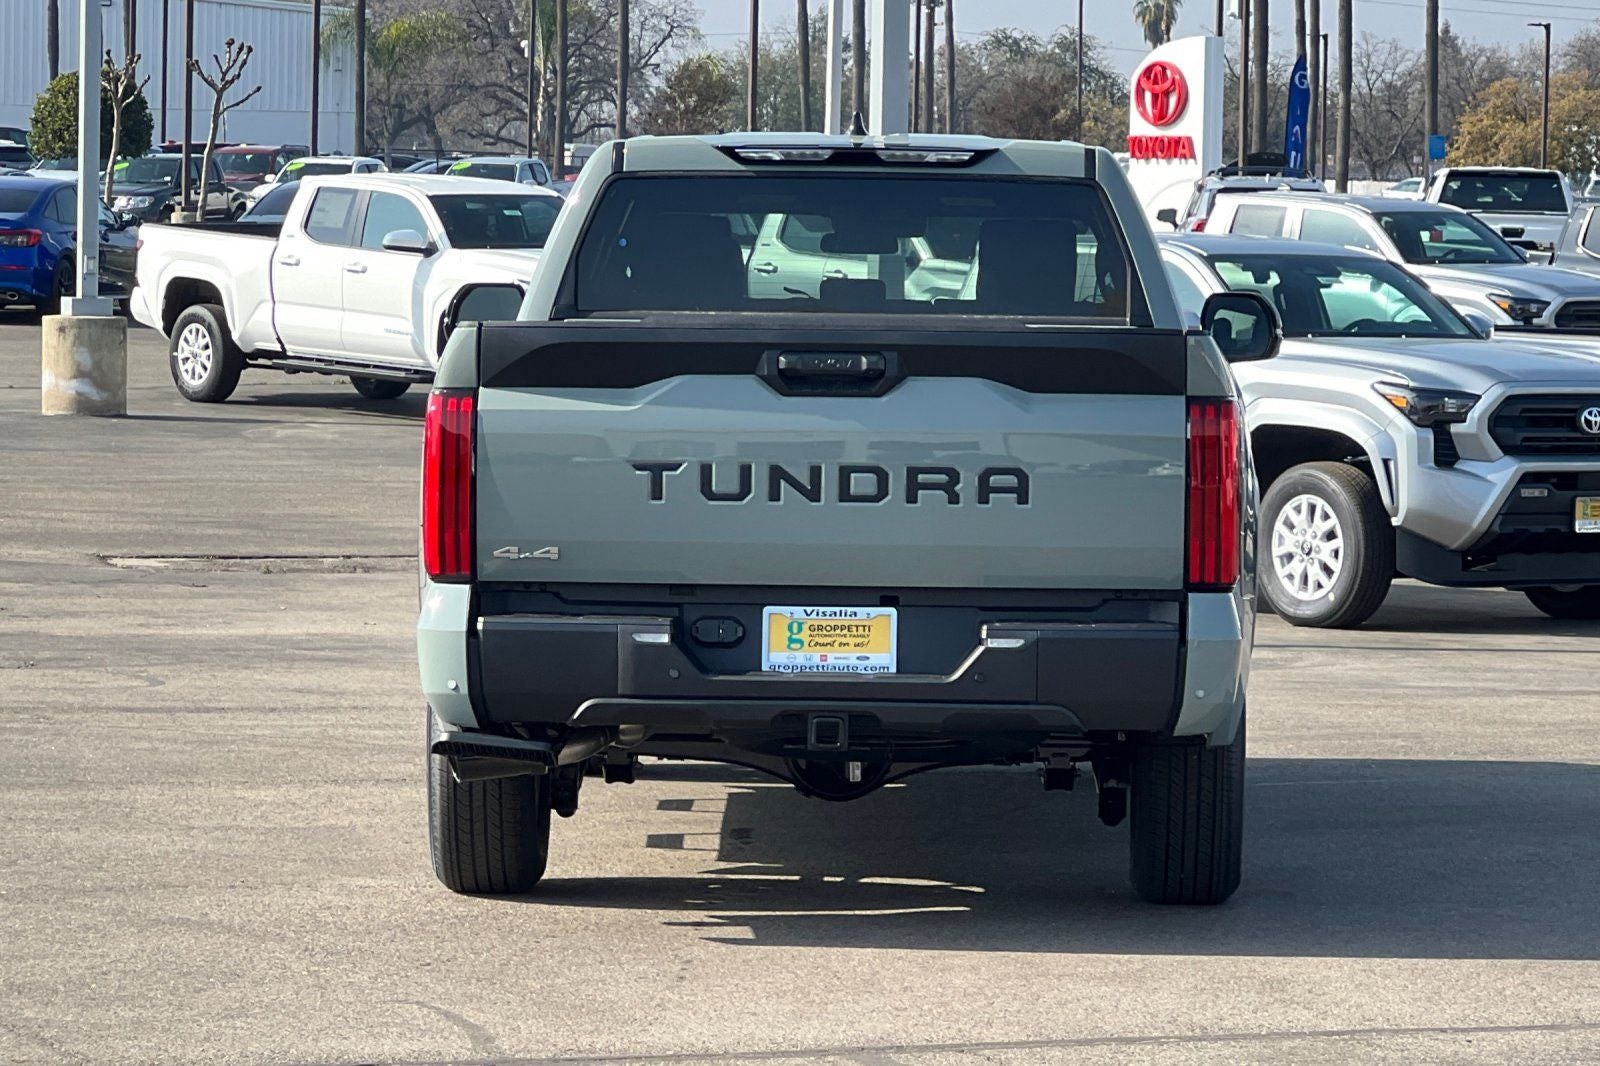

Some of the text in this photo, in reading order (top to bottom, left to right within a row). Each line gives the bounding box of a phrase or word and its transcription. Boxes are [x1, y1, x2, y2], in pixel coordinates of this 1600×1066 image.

[1127, 135, 1196, 160] TOYOTA
[631, 462, 1031, 506] TUNDRA
[803, 608, 858, 618] Visalia
[808, 624, 871, 633] GROPPETTI
[808, 639, 870, 648] Count on us!
[768, 663, 890, 673] groppettiauto.com
